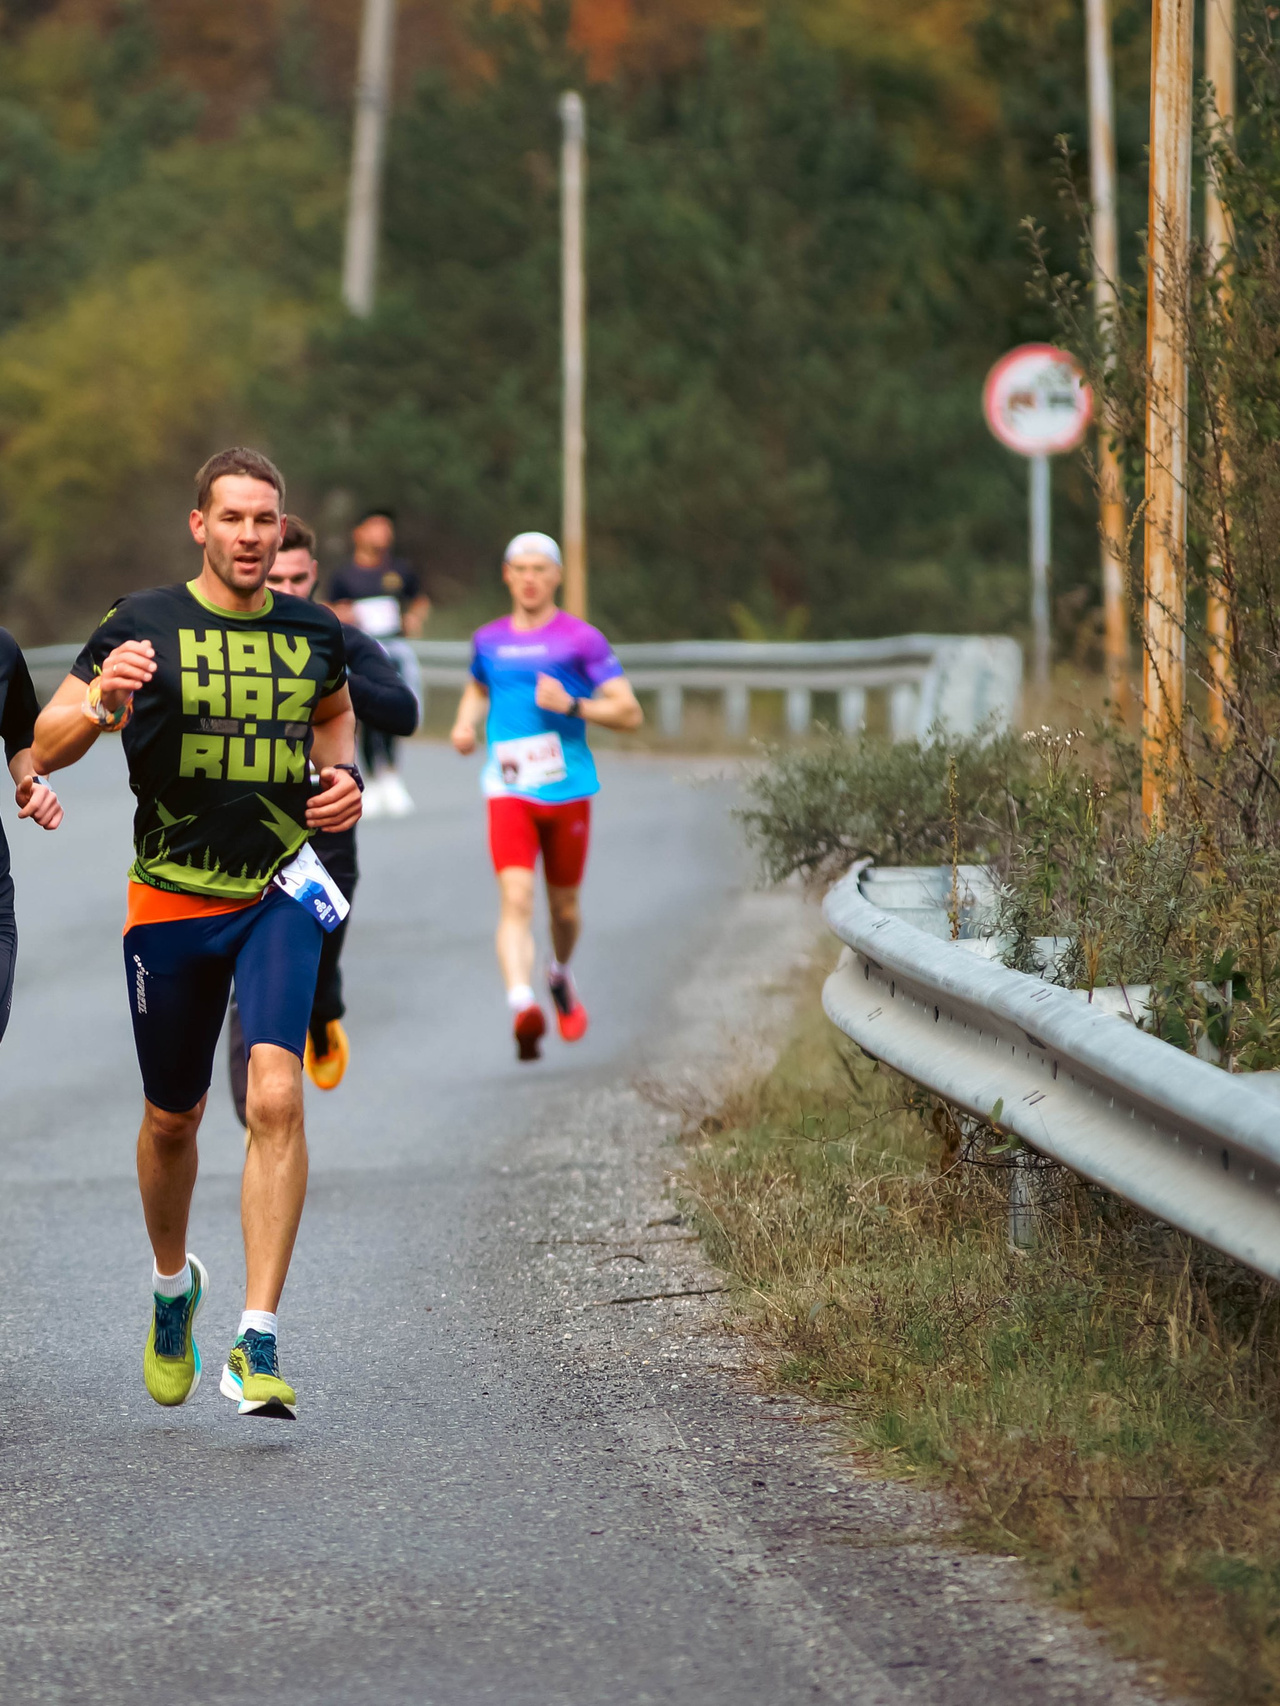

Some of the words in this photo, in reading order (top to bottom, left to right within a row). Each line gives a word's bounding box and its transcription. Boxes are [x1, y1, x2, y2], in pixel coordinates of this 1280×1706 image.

[179, 629, 312, 676] KAV
[181, 671, 317, 722] KAZ
[179, 733, 306, 783] RUN
